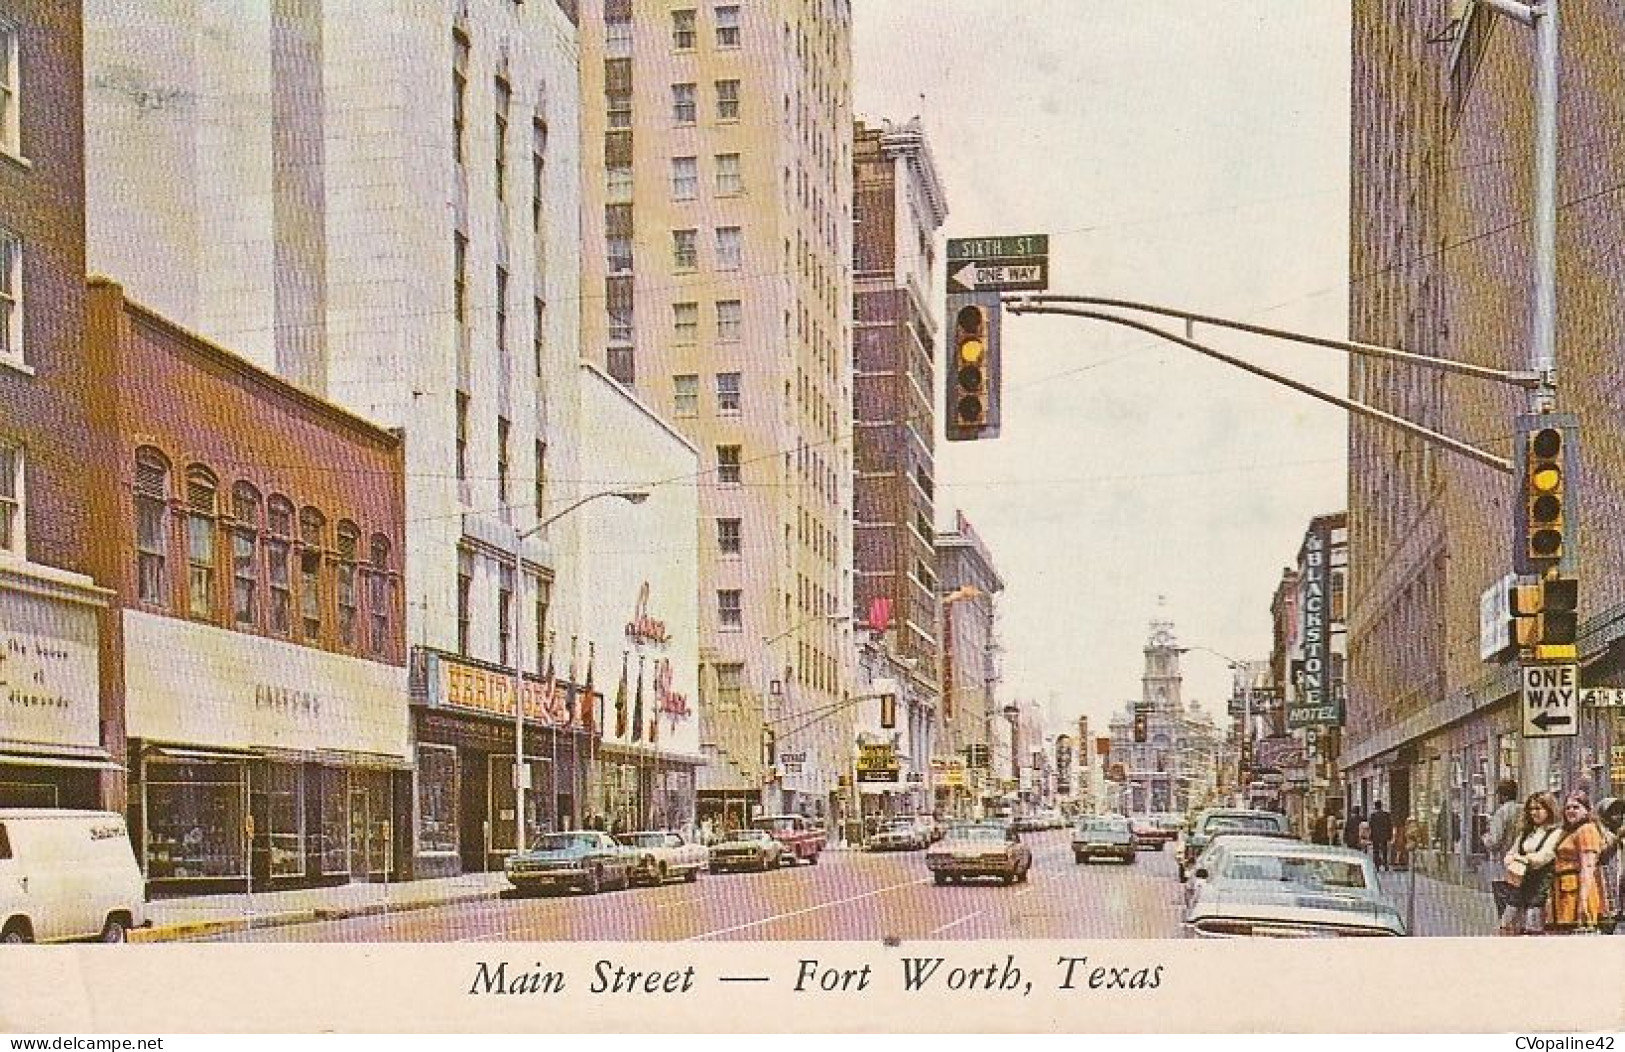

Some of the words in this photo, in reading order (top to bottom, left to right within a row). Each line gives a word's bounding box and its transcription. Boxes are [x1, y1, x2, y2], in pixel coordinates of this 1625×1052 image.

[961, 240, 1002, 257] SIXTH
[1017, 238, 1033, 255] ST
[976, 268, 1004, 283] ONE
[1009, 266, 1036, 281] WAY
[1307, 551, 1322, 704] BLACKSTONE
[1528, 669, 1572, 688] ONE
[1527, 689, 1573, 709] WAY
[1289, 706, 1338, 721] HOTEL
